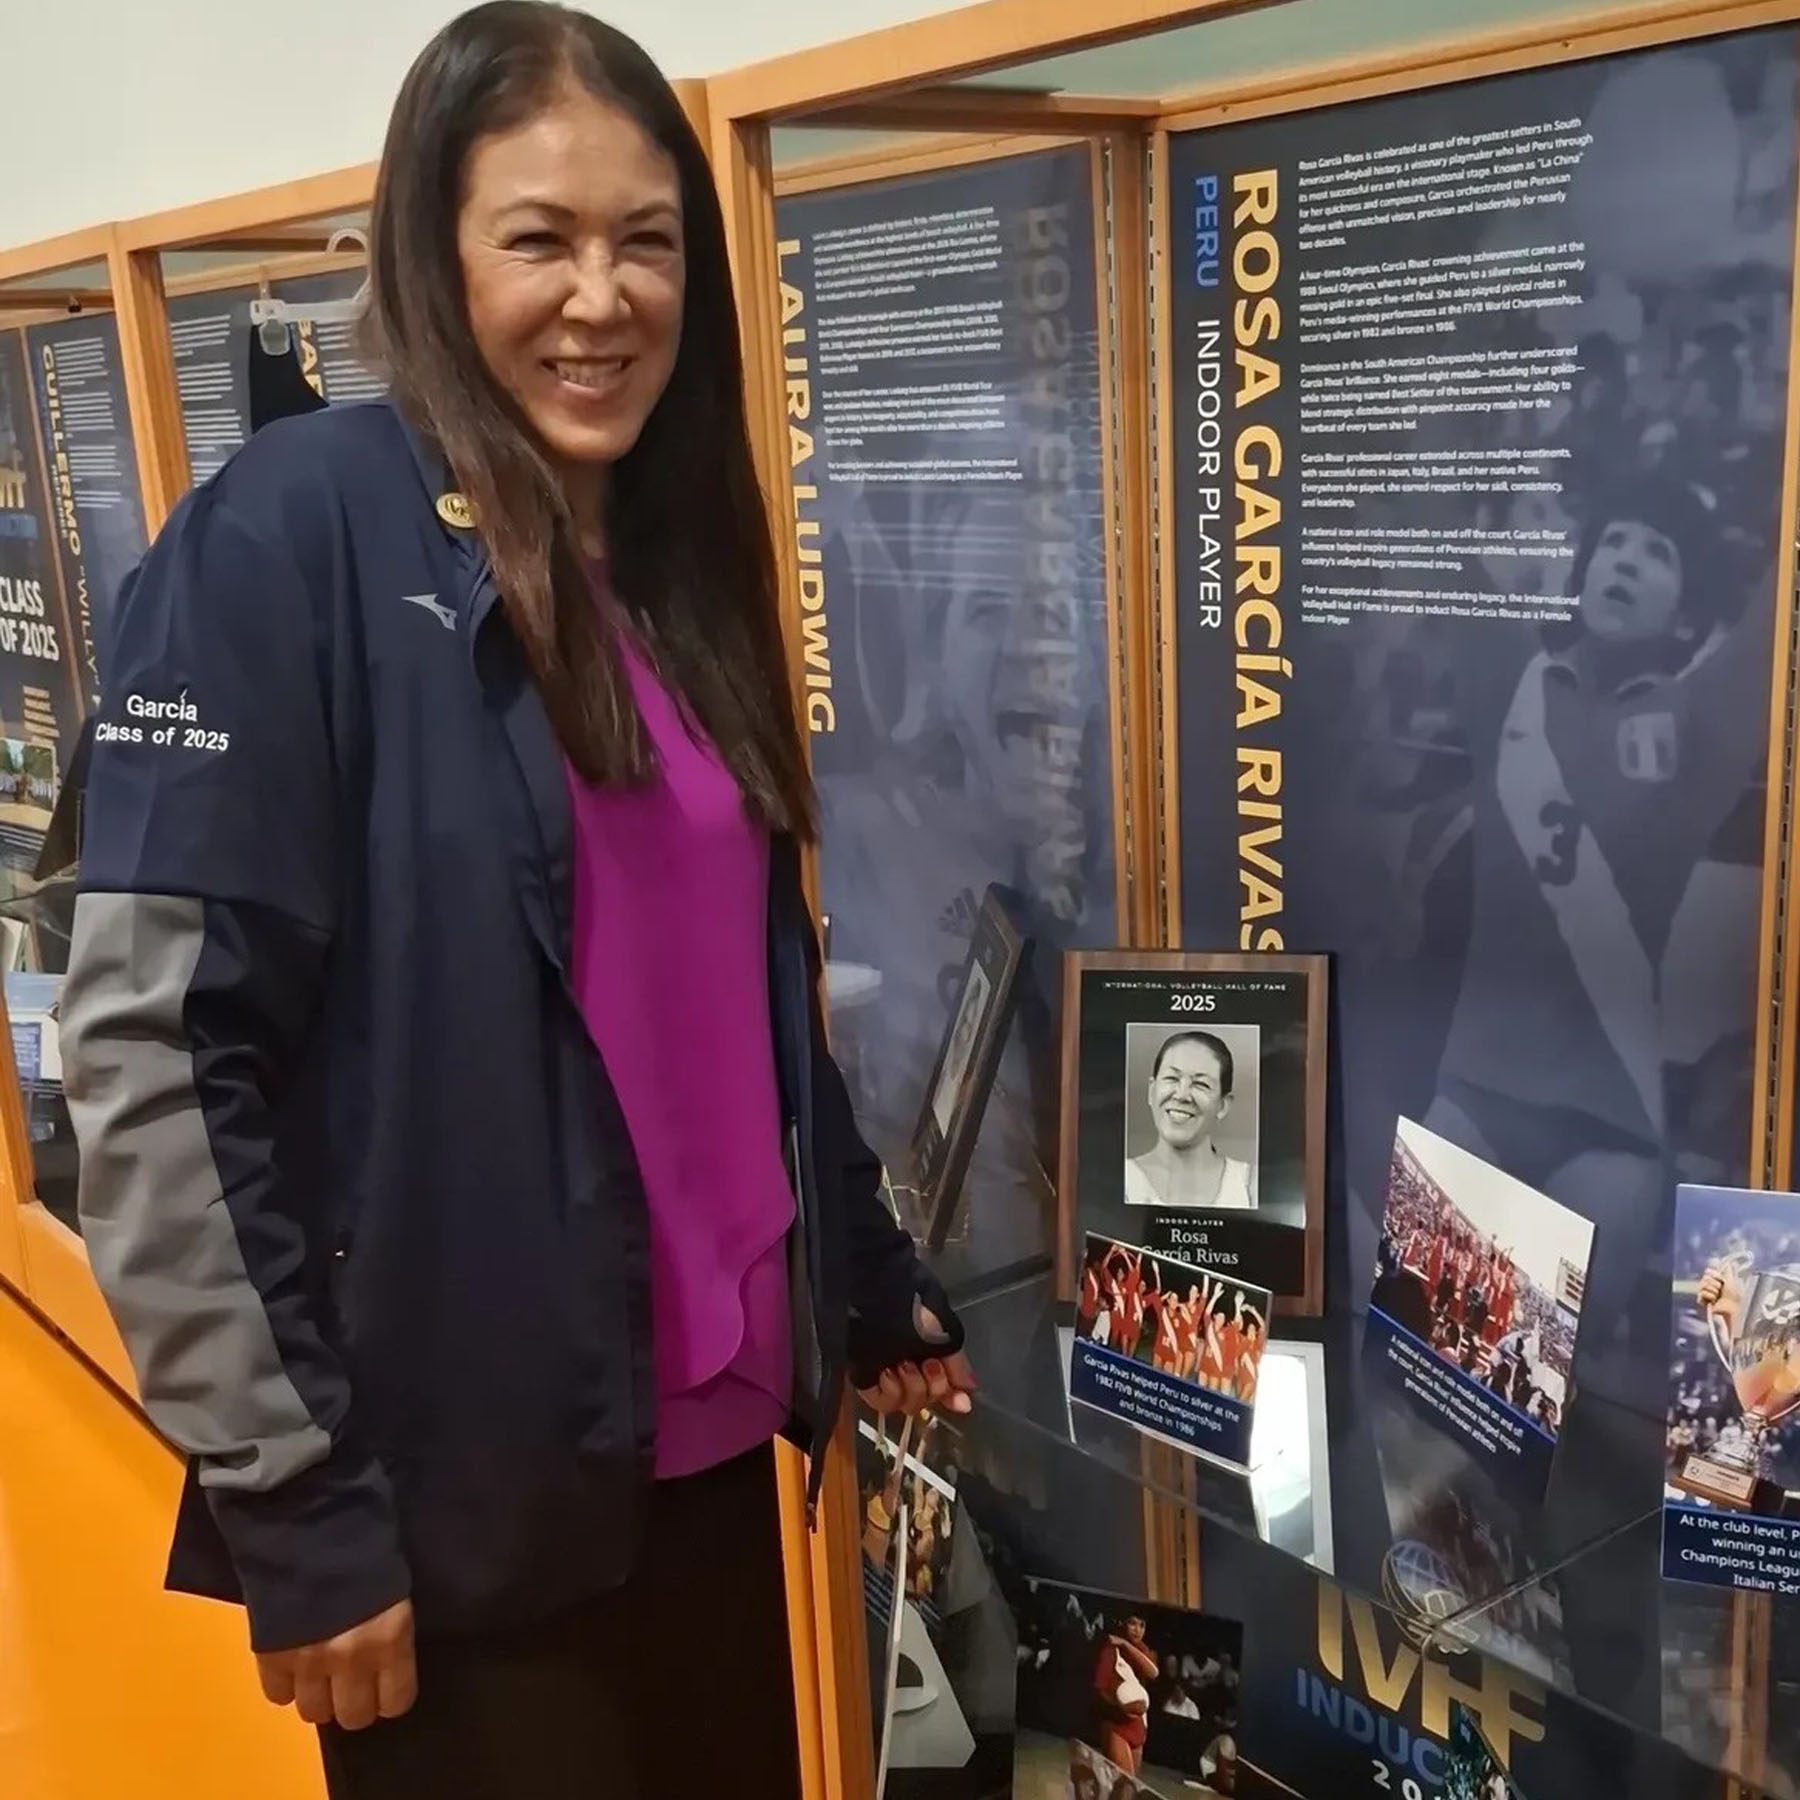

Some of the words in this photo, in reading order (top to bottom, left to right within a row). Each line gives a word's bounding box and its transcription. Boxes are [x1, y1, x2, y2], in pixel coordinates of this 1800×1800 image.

[1457, 136, 1470, 146] the
[1472, 130, 1509, 146] greatest
[1510, 126, 1542, 137] setters
[1544, 123, 1552, 132] in
[1554, 119, 1581, 130] South
[1532, 141, 1553, 151] Peru
[1555, 135, 1594, 147] through
[1494, 163, 1524, 174] Known
[1514, 180, 1528, 189] the
[1457, 202, 1473, 213] and
[1475, 198, 1520, 211] leadership
[1523, 195, 1536, 204] for
[1195, 175, 1219, 287] PERU
[1569, 242, 1584, 252] the
[1450, 272, 1468, 280] Peru
[1471, 271, 1479, 279] to
[1233, 169, 1281, 408] ROSA
[1472, 286, 1500, 296] played
[1502, 282, 1532, 293] pivotal
[1558, 279, 1566, 287] in
[1448, 305, 1462, 314] the
[777, 239, 815, 467] LAURA
[1488, 351, 1518, 360] further
[1520, 348, 1578, 358] underscored
[1530, 365, 1550, 375] four
[1197, 320, 1221, 475] INDOOR
[1446, 387, 1459, 396] the
[1562, 381, 1572, 390] to
[1519, 400, 1534, 408] her
[1536, 399, 1550, 408] the
[1198, 488, 1222, 628] PLAYER
[1234, 425, 1293, 729] GARCÍA
[0, 576, 44, 617] CLASS
[793, 485, 836, 733] LUDWIG
[0, 616, 18, 652] OF
[19, 620, 60, 662] 2025
[127, 688, 198, 722] García
[95, 722, 143, 743] Class
[152, 726, 176, 746] of
[183, 728, 230, 751] 2025
[1236, 748, 1284, 951] RIVAS
[1170, 994, 1216, 1012] 2025
[1171, 1228, 1209, 1244] Rosa
[1196, 1248, 1239, 1264] Rivas
[1131, 1371, 1159, 1391] helped
[1159, 1383, 1180, 1399] Peru
[1180, 1391, 1189, 1403] to
[1191, 1394, 1214, 1413] silver
[1214, 1404, 1224, 1416] at
[1225, 1407, 1241, 1423] the
[1134, 1387, 1158, 1406] World
[1119, 1398, 1135, 1413] and
[1136, 1404, 1163, 1425] bronze
[1165, 1415, 1173, 1426] in
[1175, 1418, 1196, 1437] 1986
[1680, 1514, 1694, 1527] At
[1697, 1516, 1720, 1530] the
[1723, 1520, 1751, 1534] club
[1754, 1524, 1788, 1541] level,
[1712, 1538, 1766, 1556] winning
[1768, 1545, 1786, 1557] an
[1681, 1549, 1756, 1571] Champions
[1733, 1573, 1775, 1591] Italian
